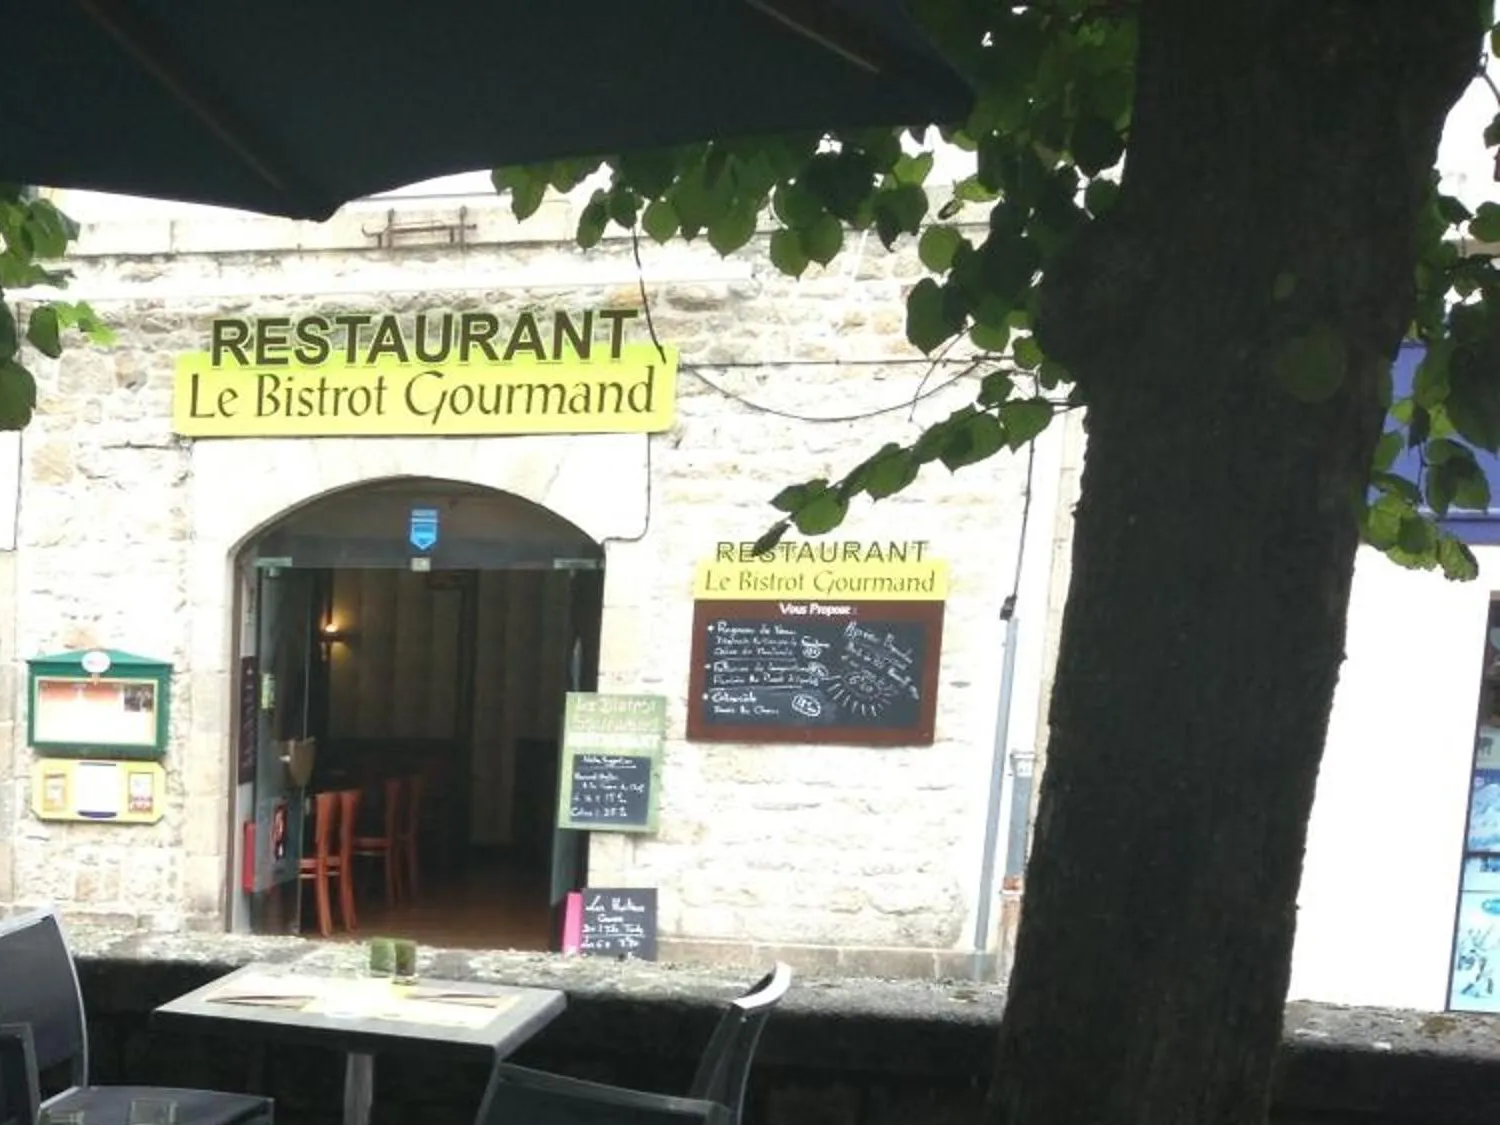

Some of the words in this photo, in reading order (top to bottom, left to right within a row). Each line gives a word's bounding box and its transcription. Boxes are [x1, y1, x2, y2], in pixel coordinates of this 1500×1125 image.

[212, 309, 639, 367] RESTAURANT
[189, 373, 238, 419] Le
[253, 373, 388, 419] Bistrot
[404, 365, 655, 425] Gourmand
[715, 541, 930, 563] RESTAURANT
[704, 569, 732, 592] Le
[738, 570, 805, 592] Bistrot
[813, 570, 935, 594] Gourmand
